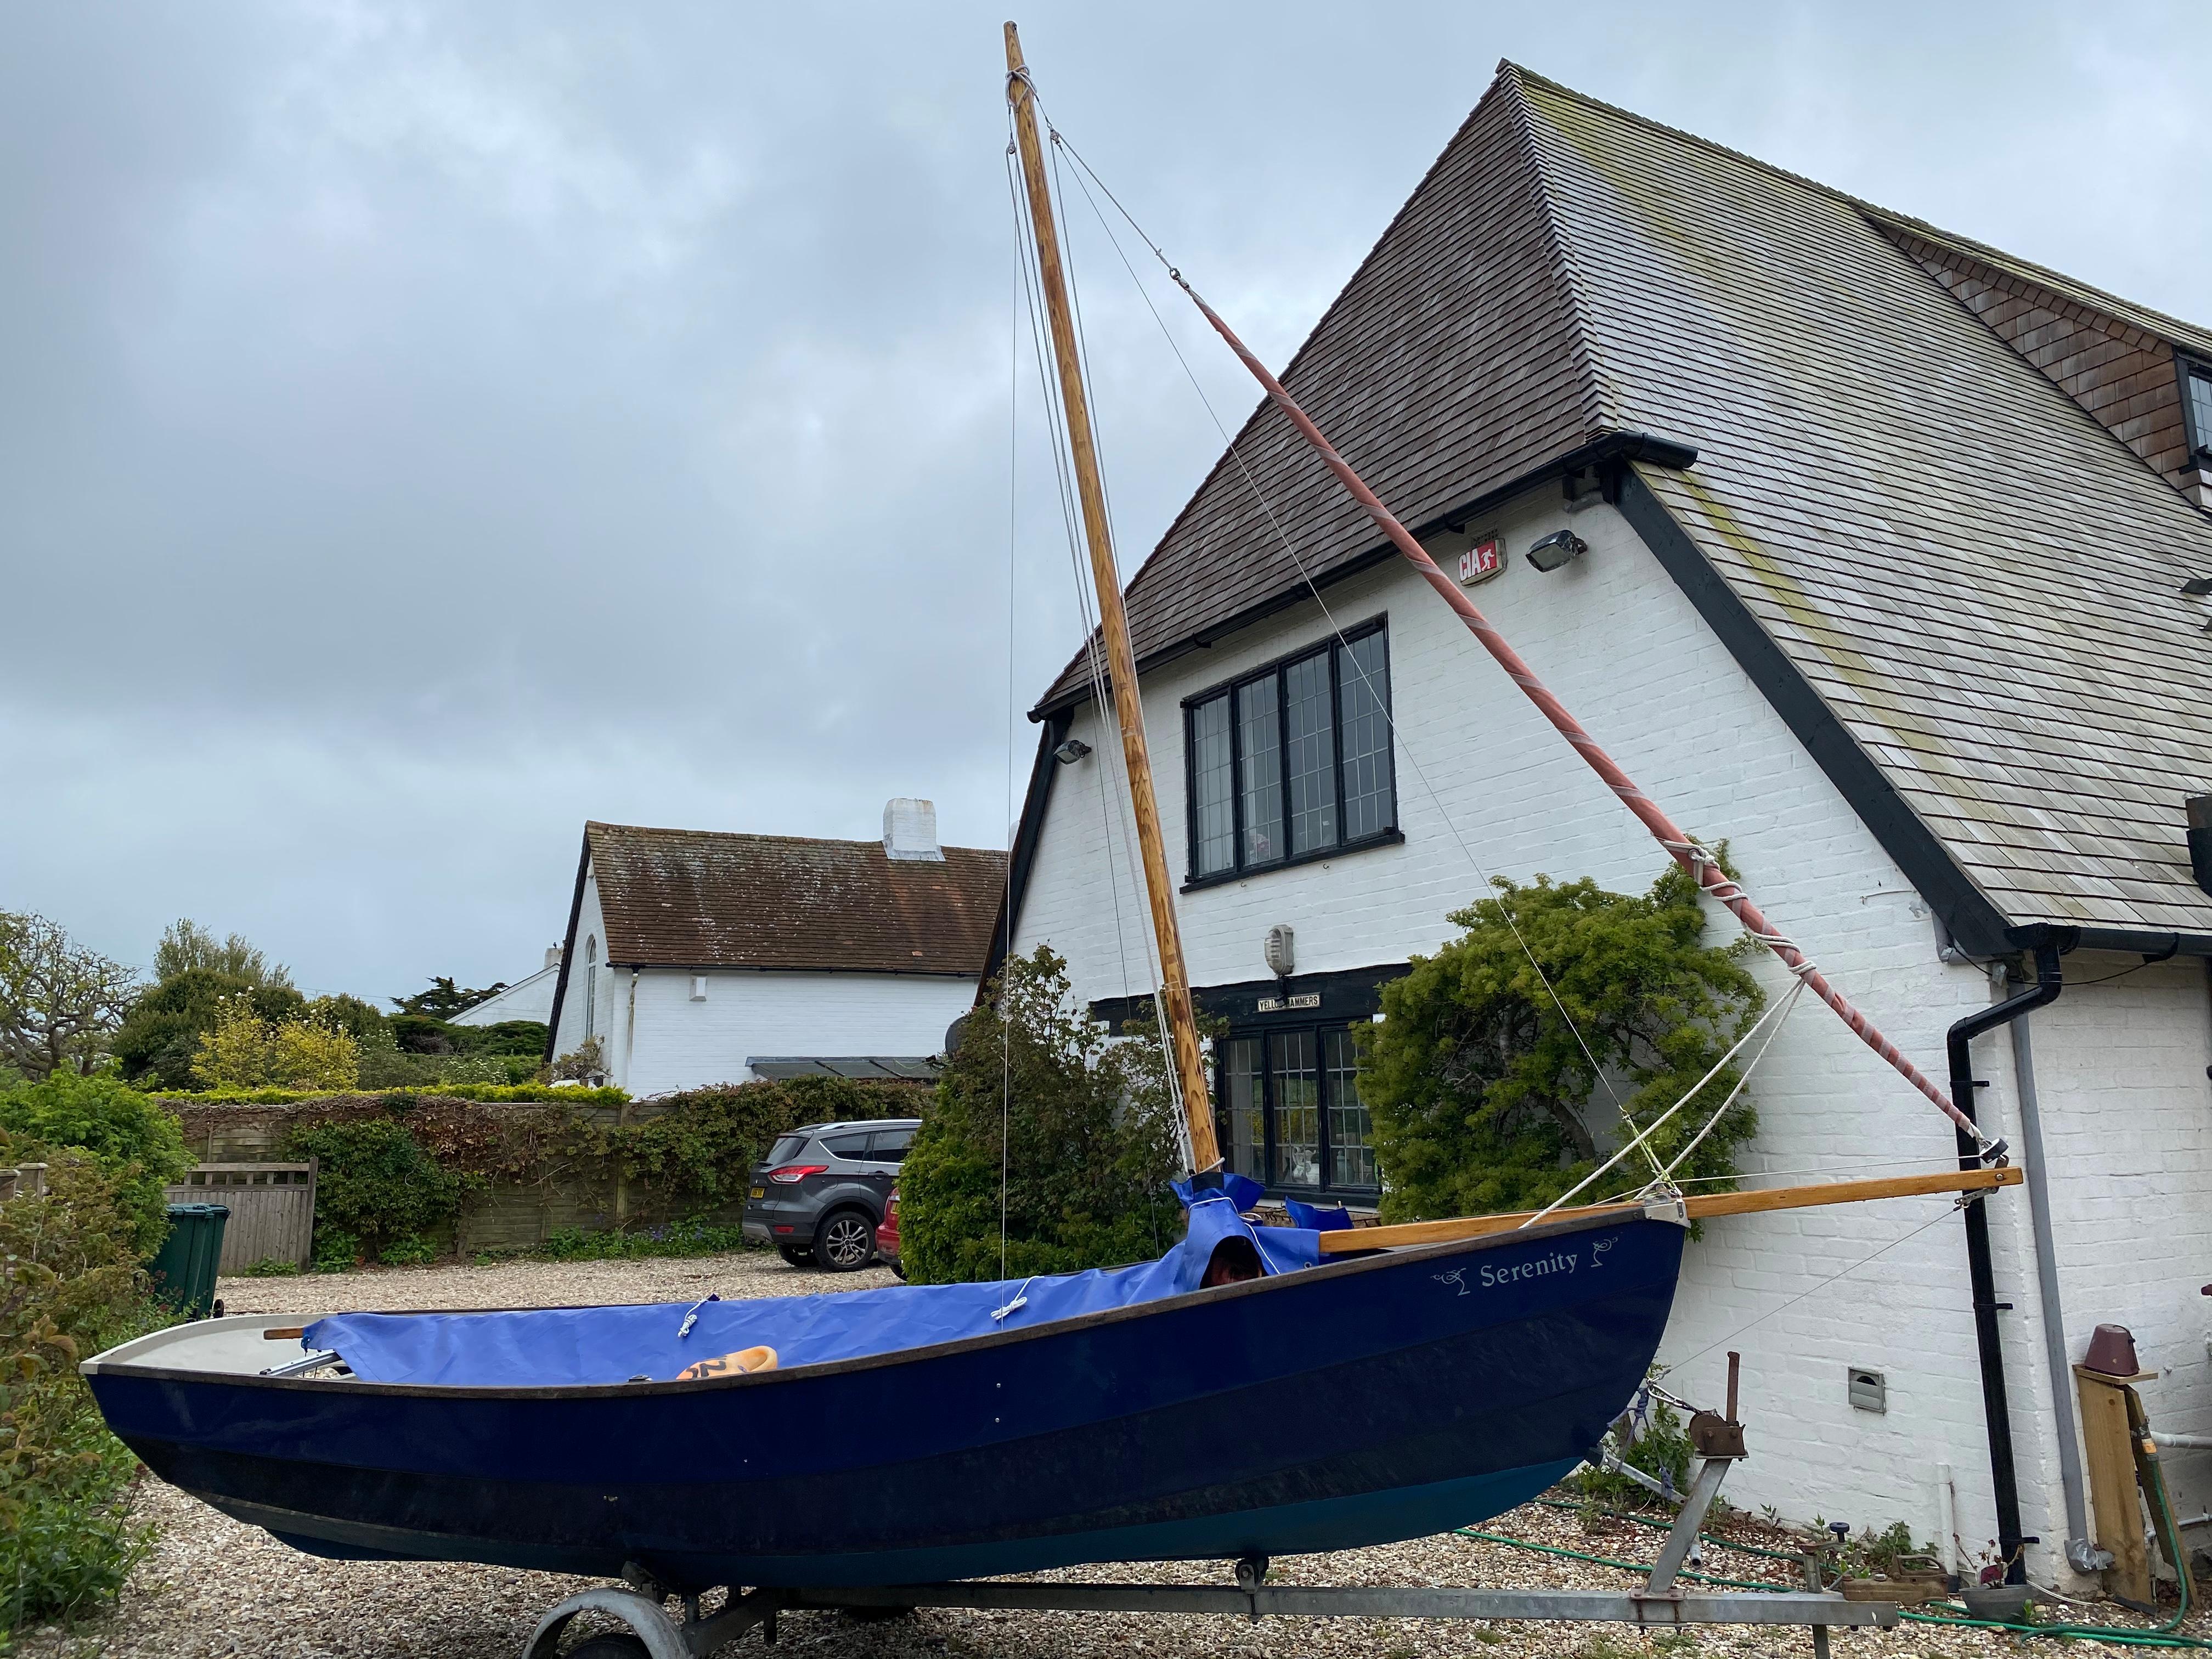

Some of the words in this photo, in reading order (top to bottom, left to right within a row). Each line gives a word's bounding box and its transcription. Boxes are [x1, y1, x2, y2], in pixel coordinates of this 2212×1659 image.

[1459, 548, 1481, 581] CIA
[1260, 996, 1318, 1011] YELLOHAMMERS
[1481, 1252, 1577, 1287] Serenity
